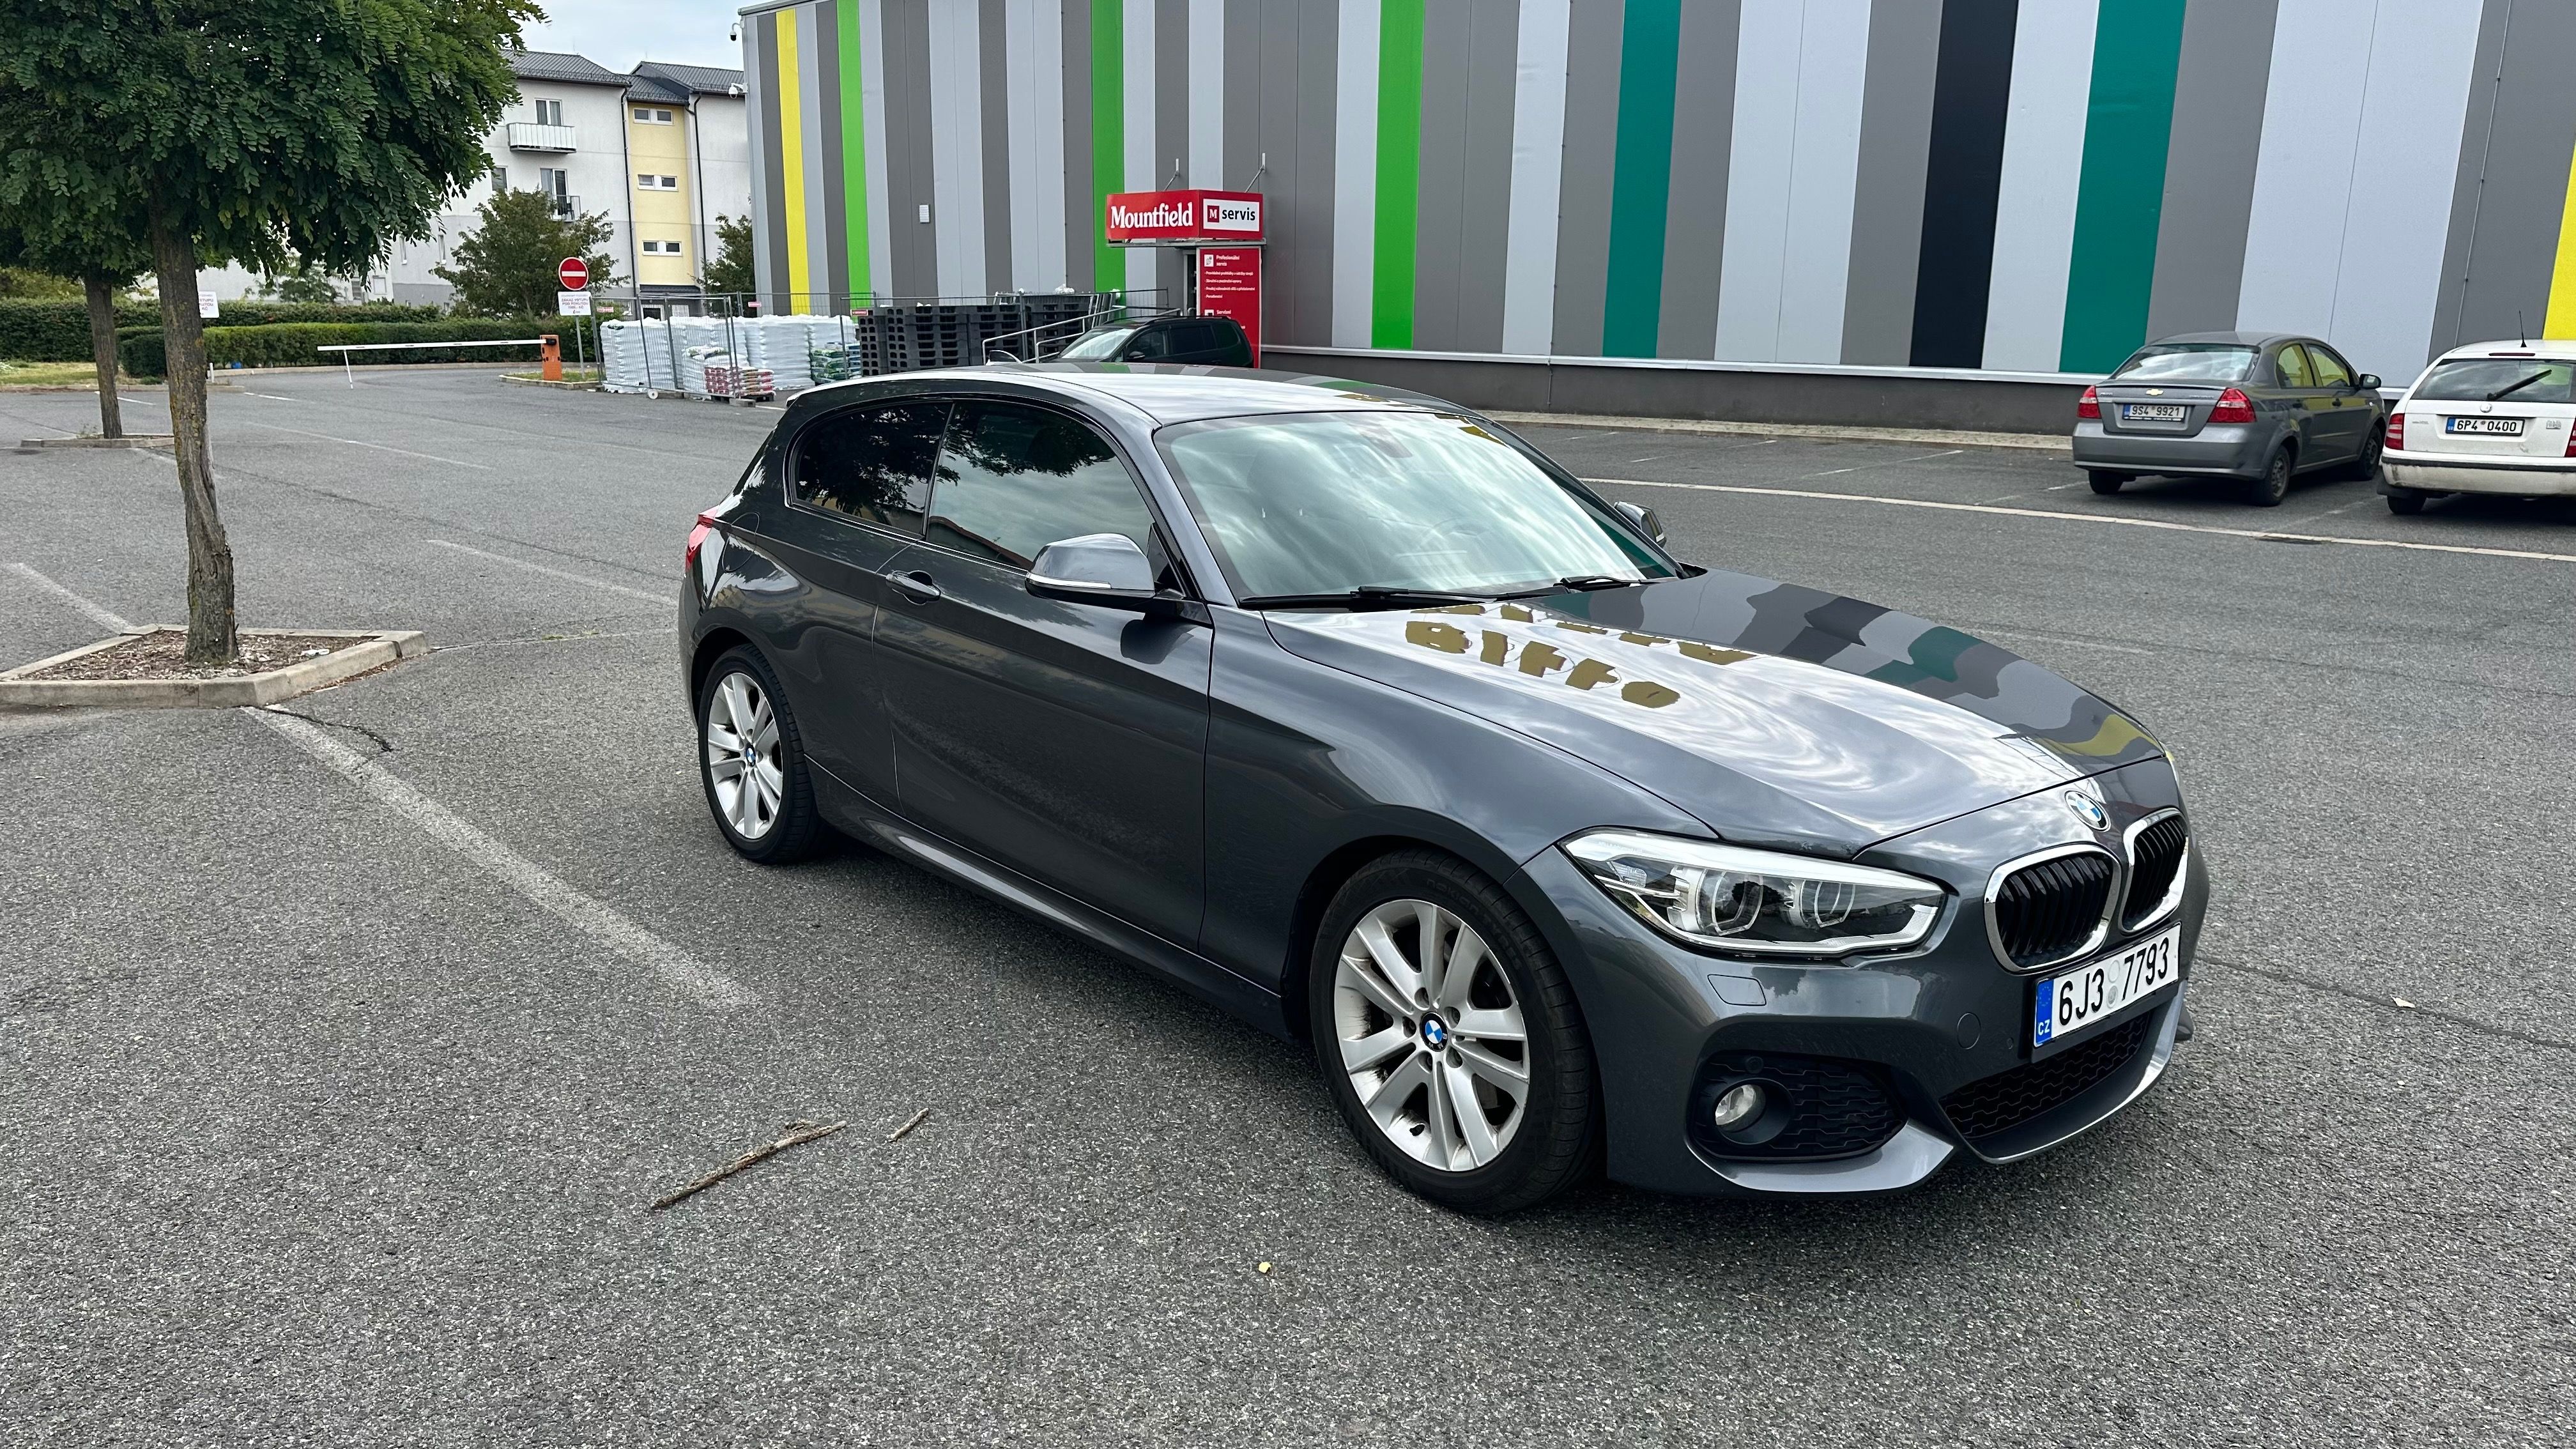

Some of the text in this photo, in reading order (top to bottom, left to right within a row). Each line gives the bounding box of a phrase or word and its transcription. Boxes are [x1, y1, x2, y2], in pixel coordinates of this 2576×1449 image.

[1110, 201, 1193, 229] Mountfield
[1209, 207, 1255, 221] M servis
[2132, 406, 2179, 417] 9S4 9921
[2457, 420, 2478, 431] 6P4
[2487, 421, 2517, 432] 0400
[2058, 937, 2169, 1026] 6J3 7793
[2037, 1019, 2050, 1036] CZ
